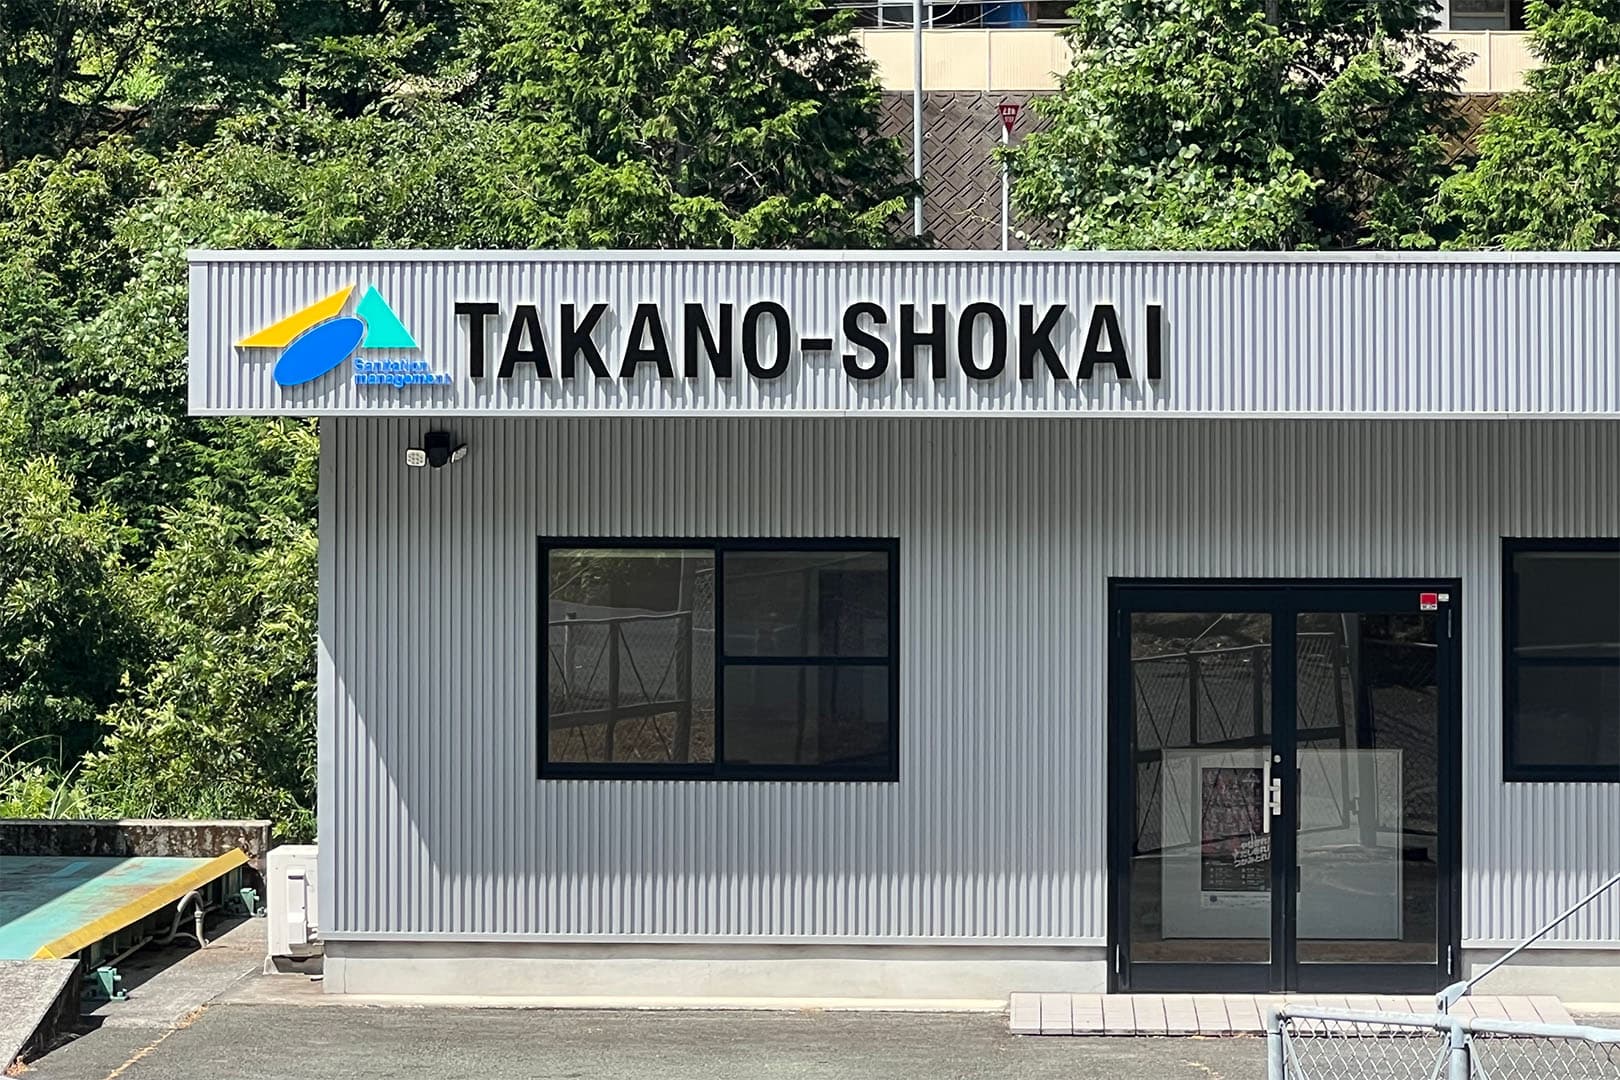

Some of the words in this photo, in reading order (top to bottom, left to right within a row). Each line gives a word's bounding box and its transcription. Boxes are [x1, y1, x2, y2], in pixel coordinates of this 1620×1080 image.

[454, 301, 1162, 381] TAKANO-SHOKAI
[354, 357, 428, 372] Sanitation
[354, 372, 452, 388] management
